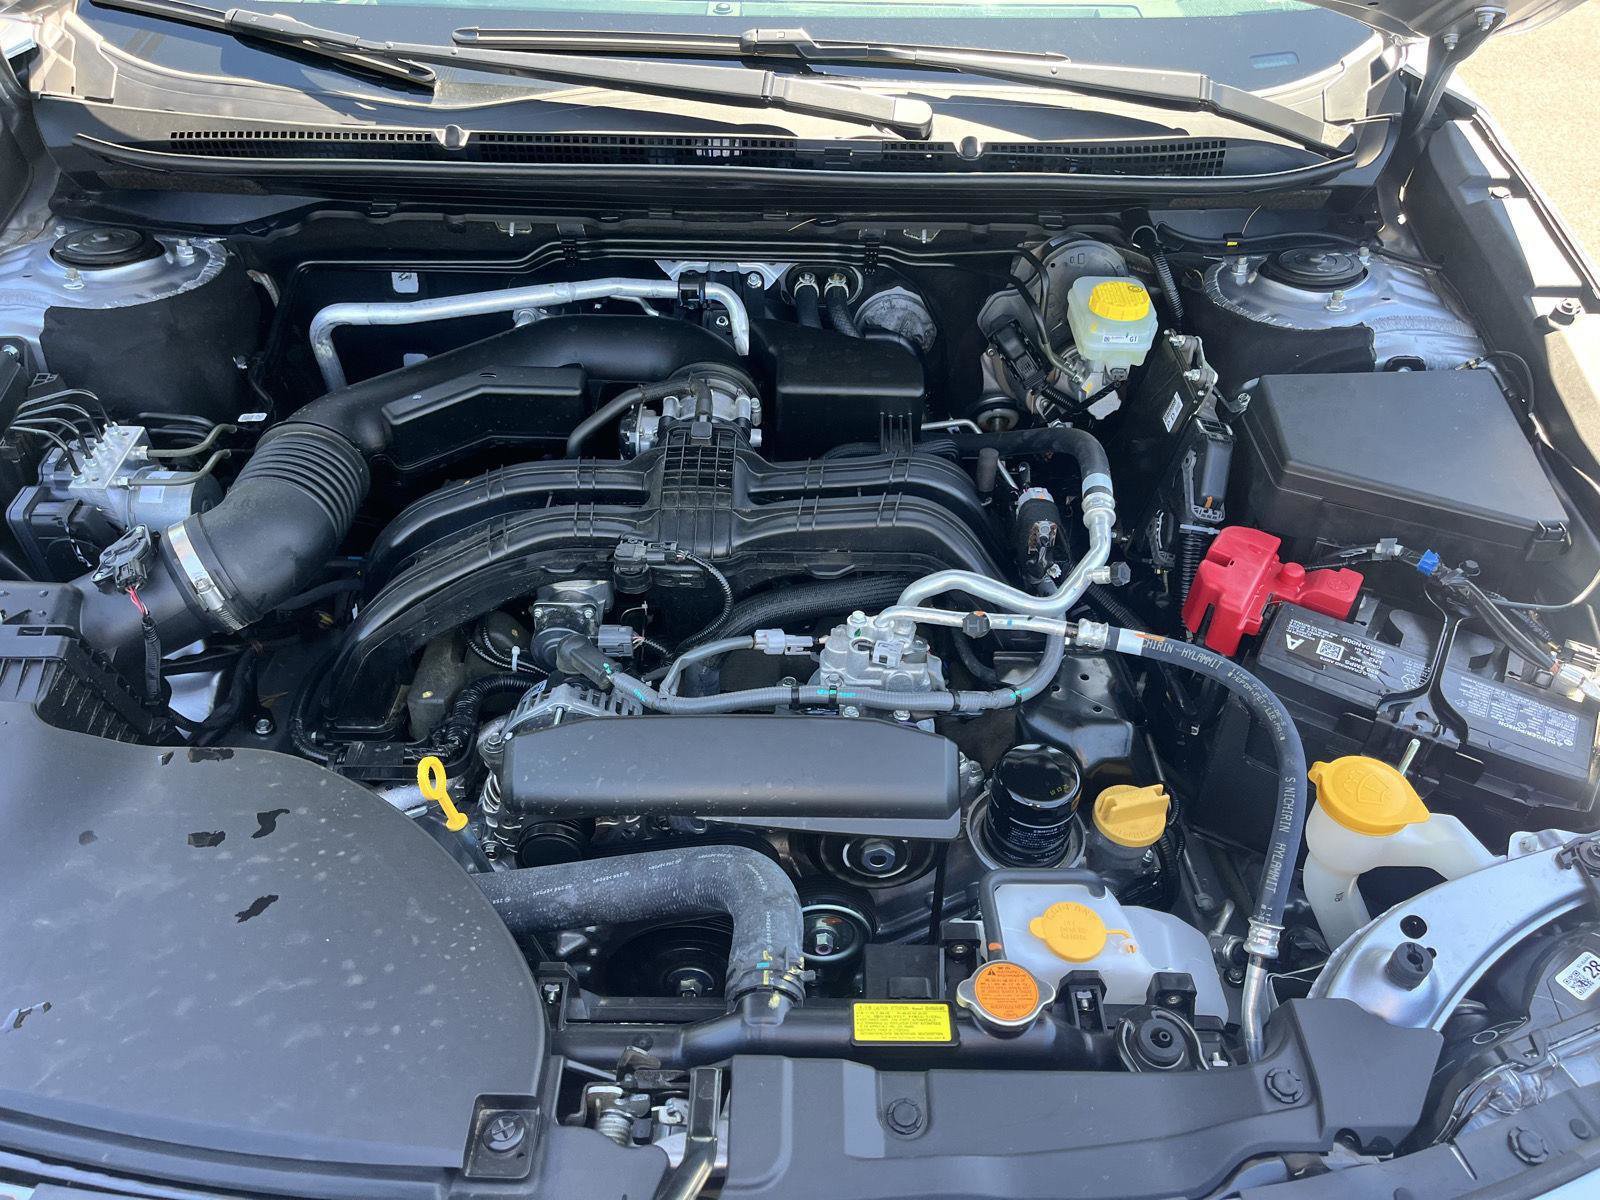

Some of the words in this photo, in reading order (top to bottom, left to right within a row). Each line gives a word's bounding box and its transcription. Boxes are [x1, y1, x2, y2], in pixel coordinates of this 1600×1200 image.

[1141, 637, 1174, 654] CHIRIN
[1343, 658, 1365, 670] AMPS
[1277, 786, 1294, 833] NICHIRIN
[1265, 841, 1286, 894] HYLAMMIT
